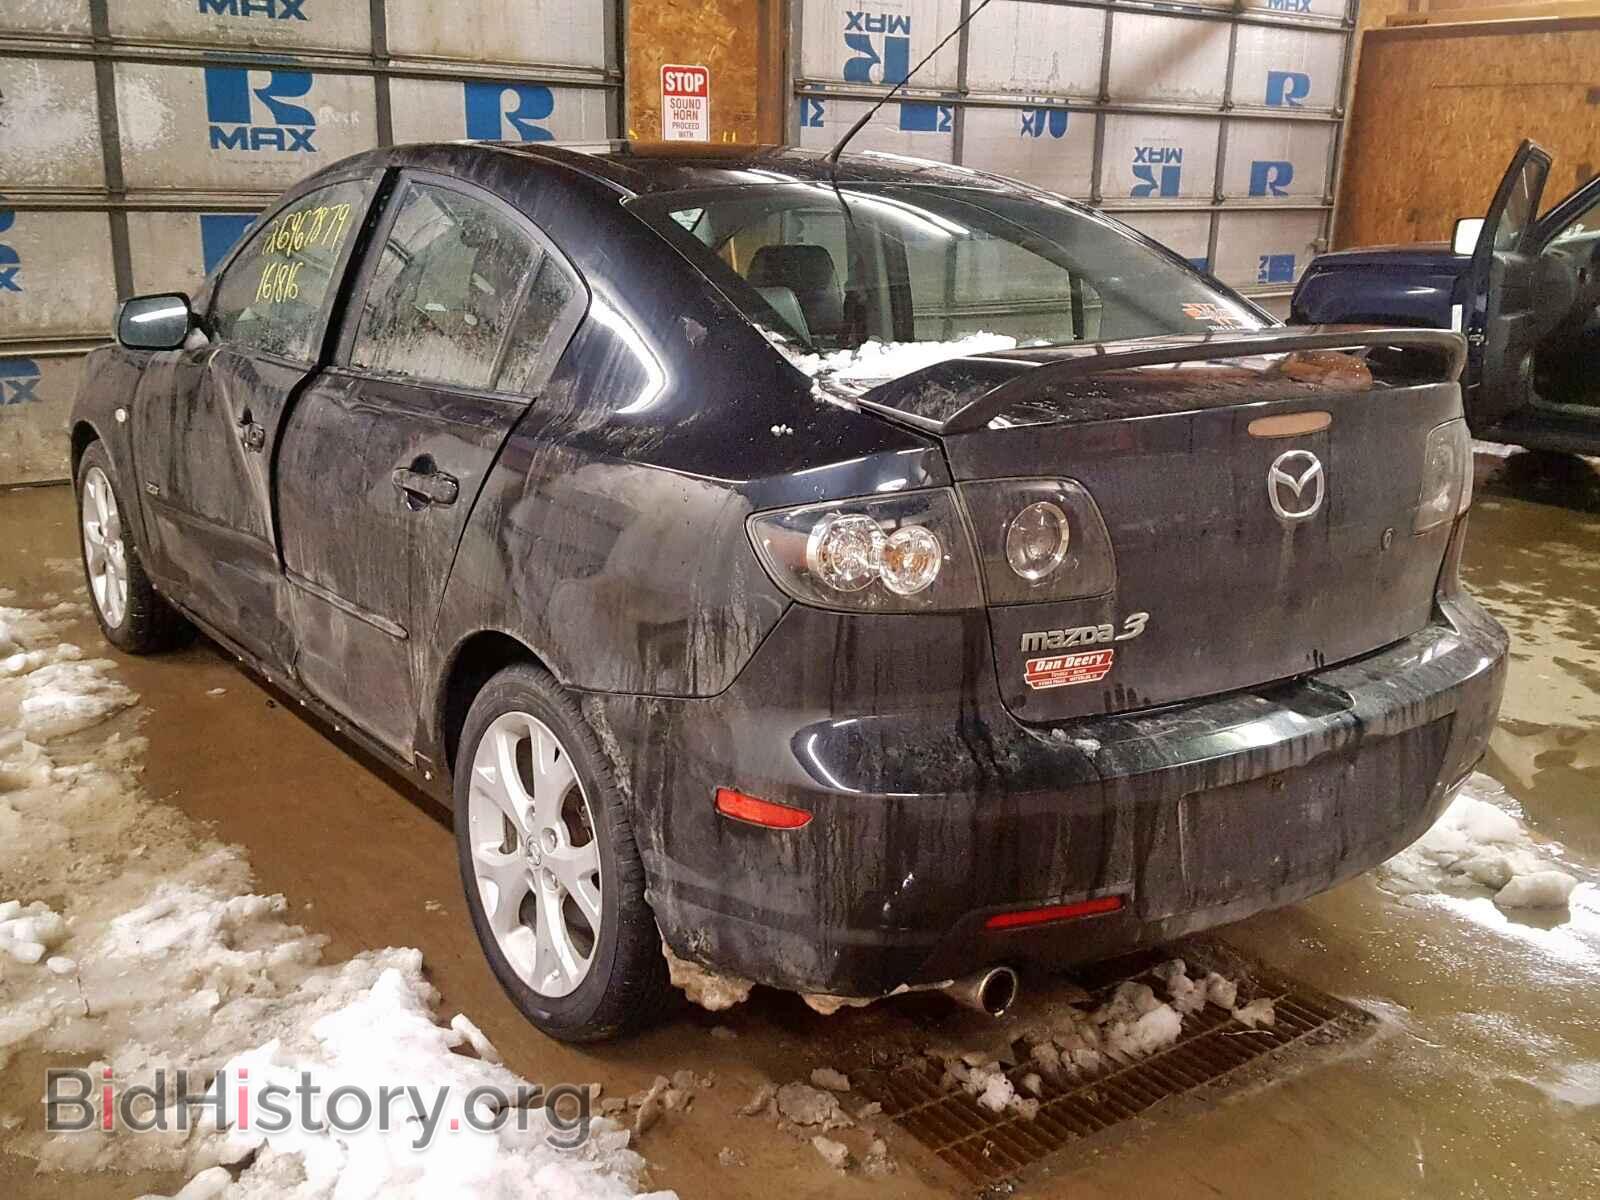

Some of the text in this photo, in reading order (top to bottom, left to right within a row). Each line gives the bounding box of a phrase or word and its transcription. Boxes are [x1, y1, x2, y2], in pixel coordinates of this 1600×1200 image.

[199, 0, 308, 21] MAX
[1268, 0, 1312, 13] MAX
[845, 10, 911, 35] MAX
[665, 71, 705, 93] STOP
[204, 67, 316, 126] R
[670, 97, 702, 110] SOUND
[464, 81, 556, 141] R
[672, 109, 699, 121] HORN
[672, 121, 700, 130] PROCEED
[678, 130, 694, 138] WITH
[209, 125, 318, 153] MAX
[1133, 146, 1183, 164] MAX
[1113, 611, 1150, 641] 3
[1034, 653, 1105, 672] Dan Deery
